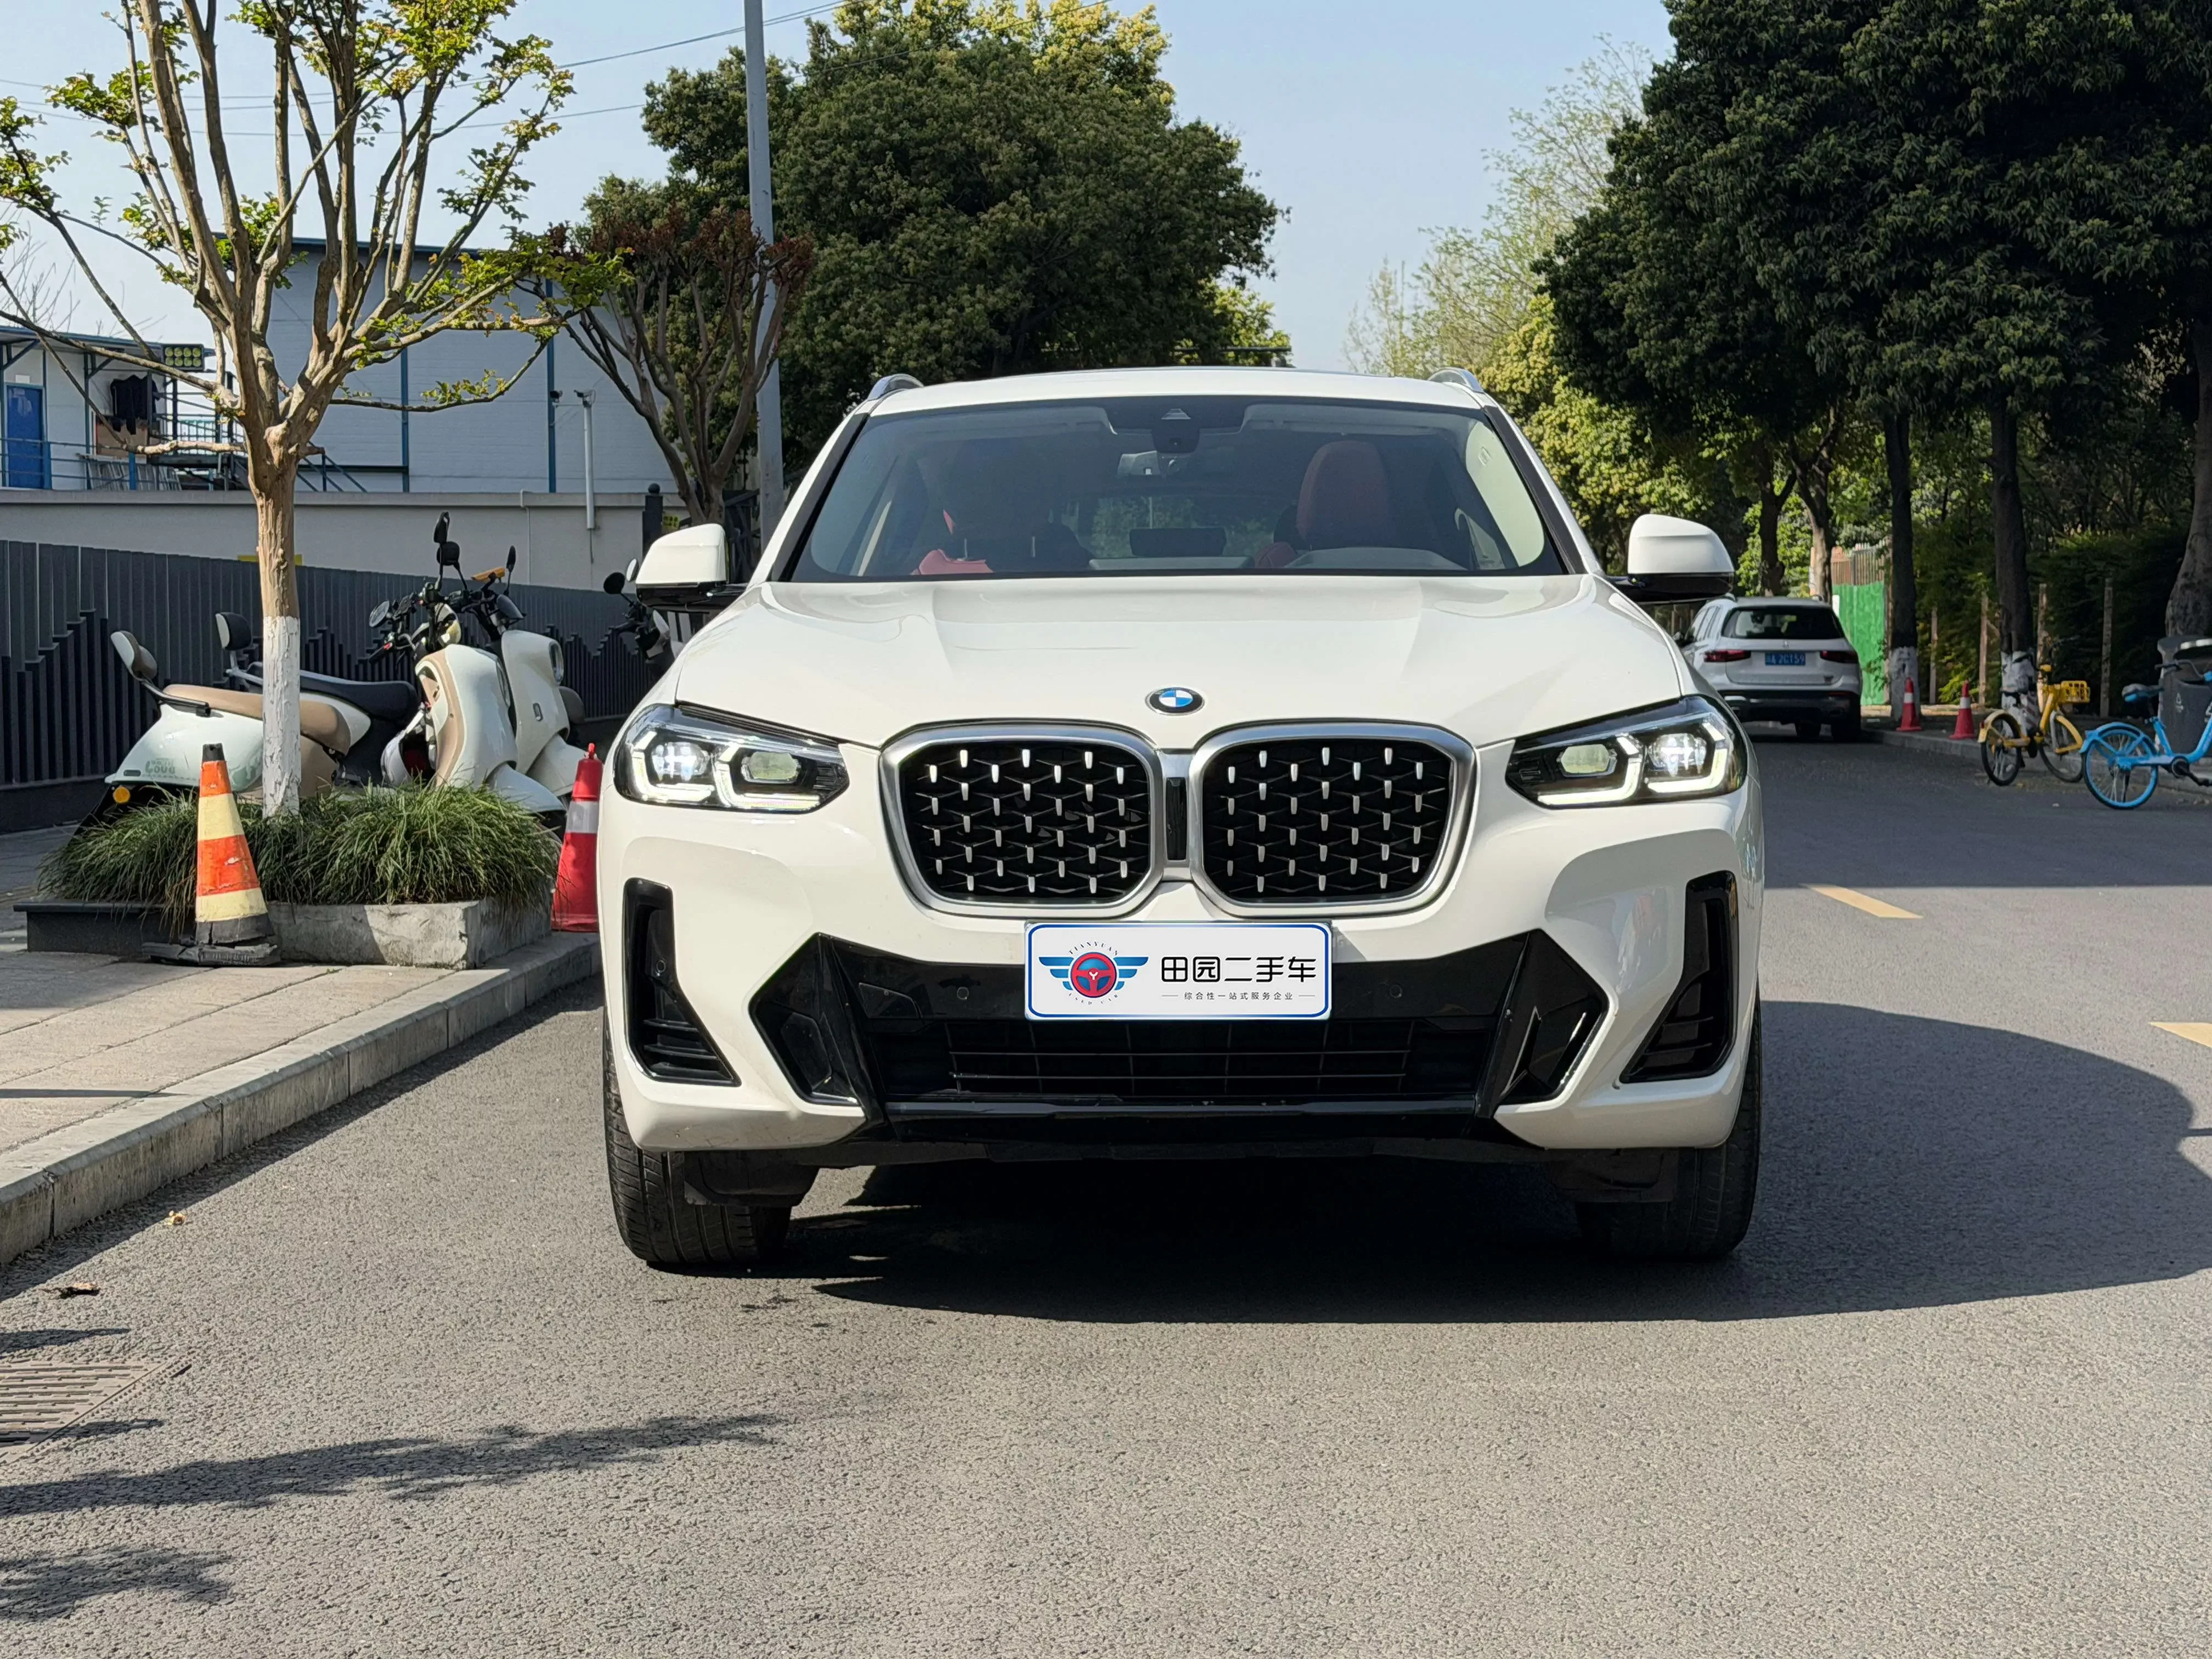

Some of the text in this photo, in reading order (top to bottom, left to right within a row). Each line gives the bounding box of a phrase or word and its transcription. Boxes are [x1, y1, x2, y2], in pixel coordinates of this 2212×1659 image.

[1161, 956, 1317, 983] 田园二手车
[1184, 991, 1293, 1001] 综合性一站式服务企业
